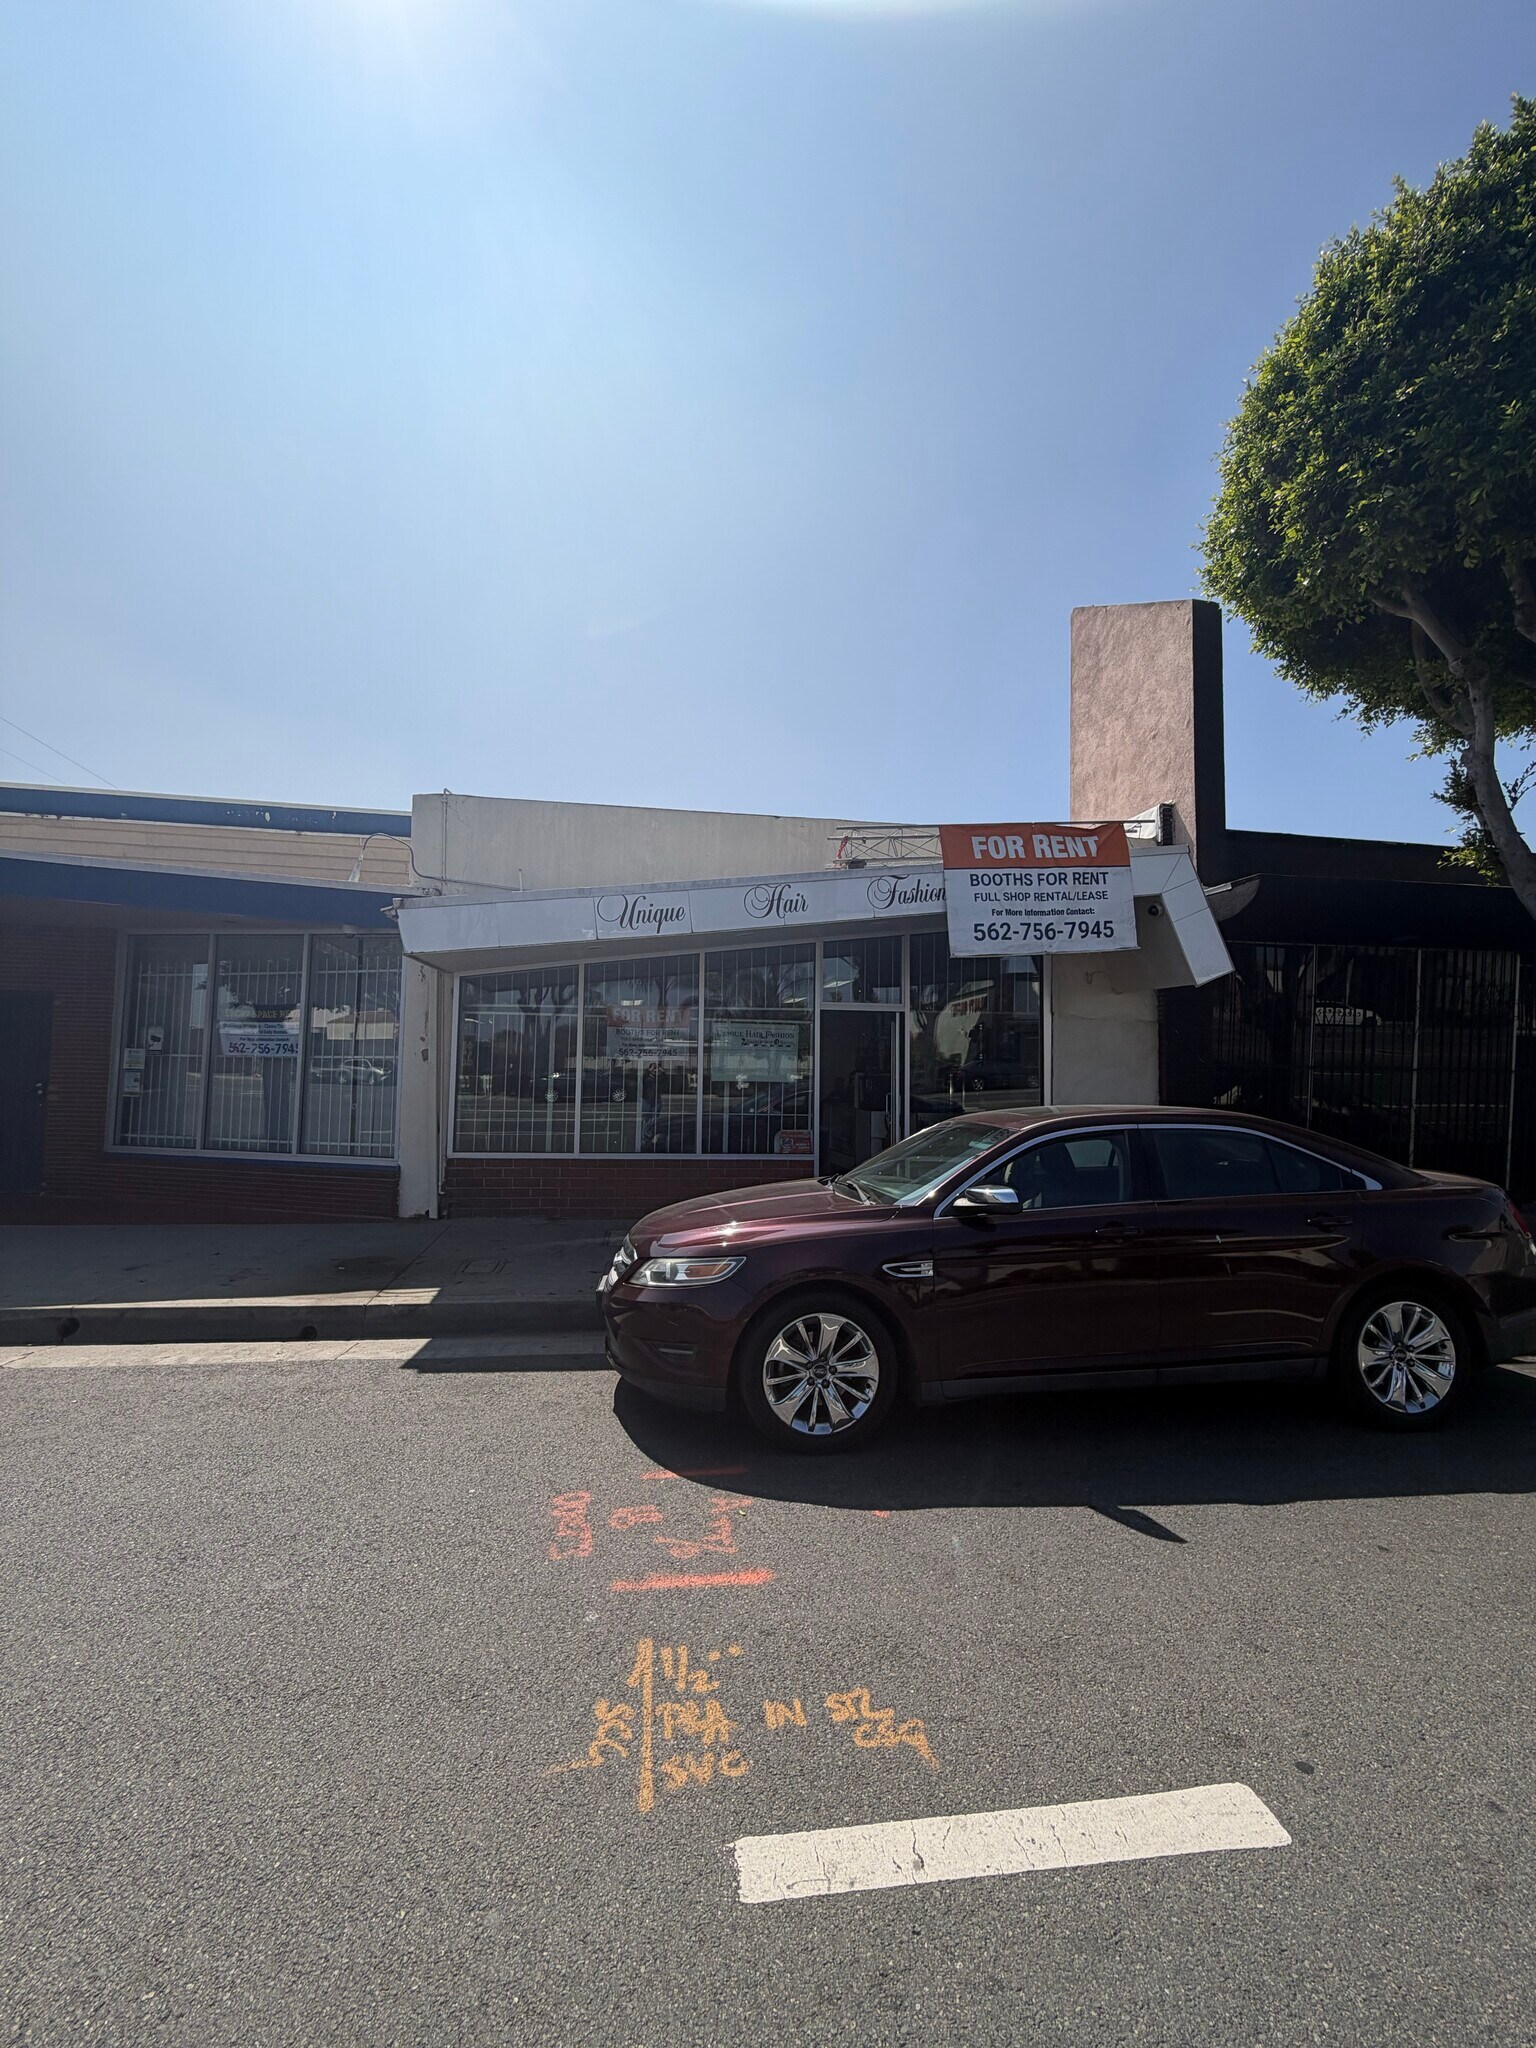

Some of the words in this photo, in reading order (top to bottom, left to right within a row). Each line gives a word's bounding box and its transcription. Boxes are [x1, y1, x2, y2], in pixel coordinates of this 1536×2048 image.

[971, 834, 1024, 860] FOR
[1032, 833, 1099, 859] RENT
[969, 872, 1033, 887] BOOTHS
[1037, 871, 1069, 886] FOR
[1072, 871, 1109, 885] RENT
[596, 893, 686, 934] Unique
[744, 883, 809, 918] Hair
[866, 873, 946, 909] Fashion
[973, 892, 1000, 902] FULL
[1002, 891, 1031, 902] SHOP
[1033, 890, 1109, 902] RENTAL/LEASE
[991, 908, 1003, 916] For
[1004, 908, 1023, 916] More
[1024, 907, 1065, 916] Information
[1065, 907, 1095, 916] Contact:
[973, 920, 1115, 941] 562-756-7945
[613, 1007, 640, 1022] FOR
[646, 1009, 684, 1023] RENT
[745, 1029, 763, 1038] HAIR
[762, 1697, 808, 1731] IN
